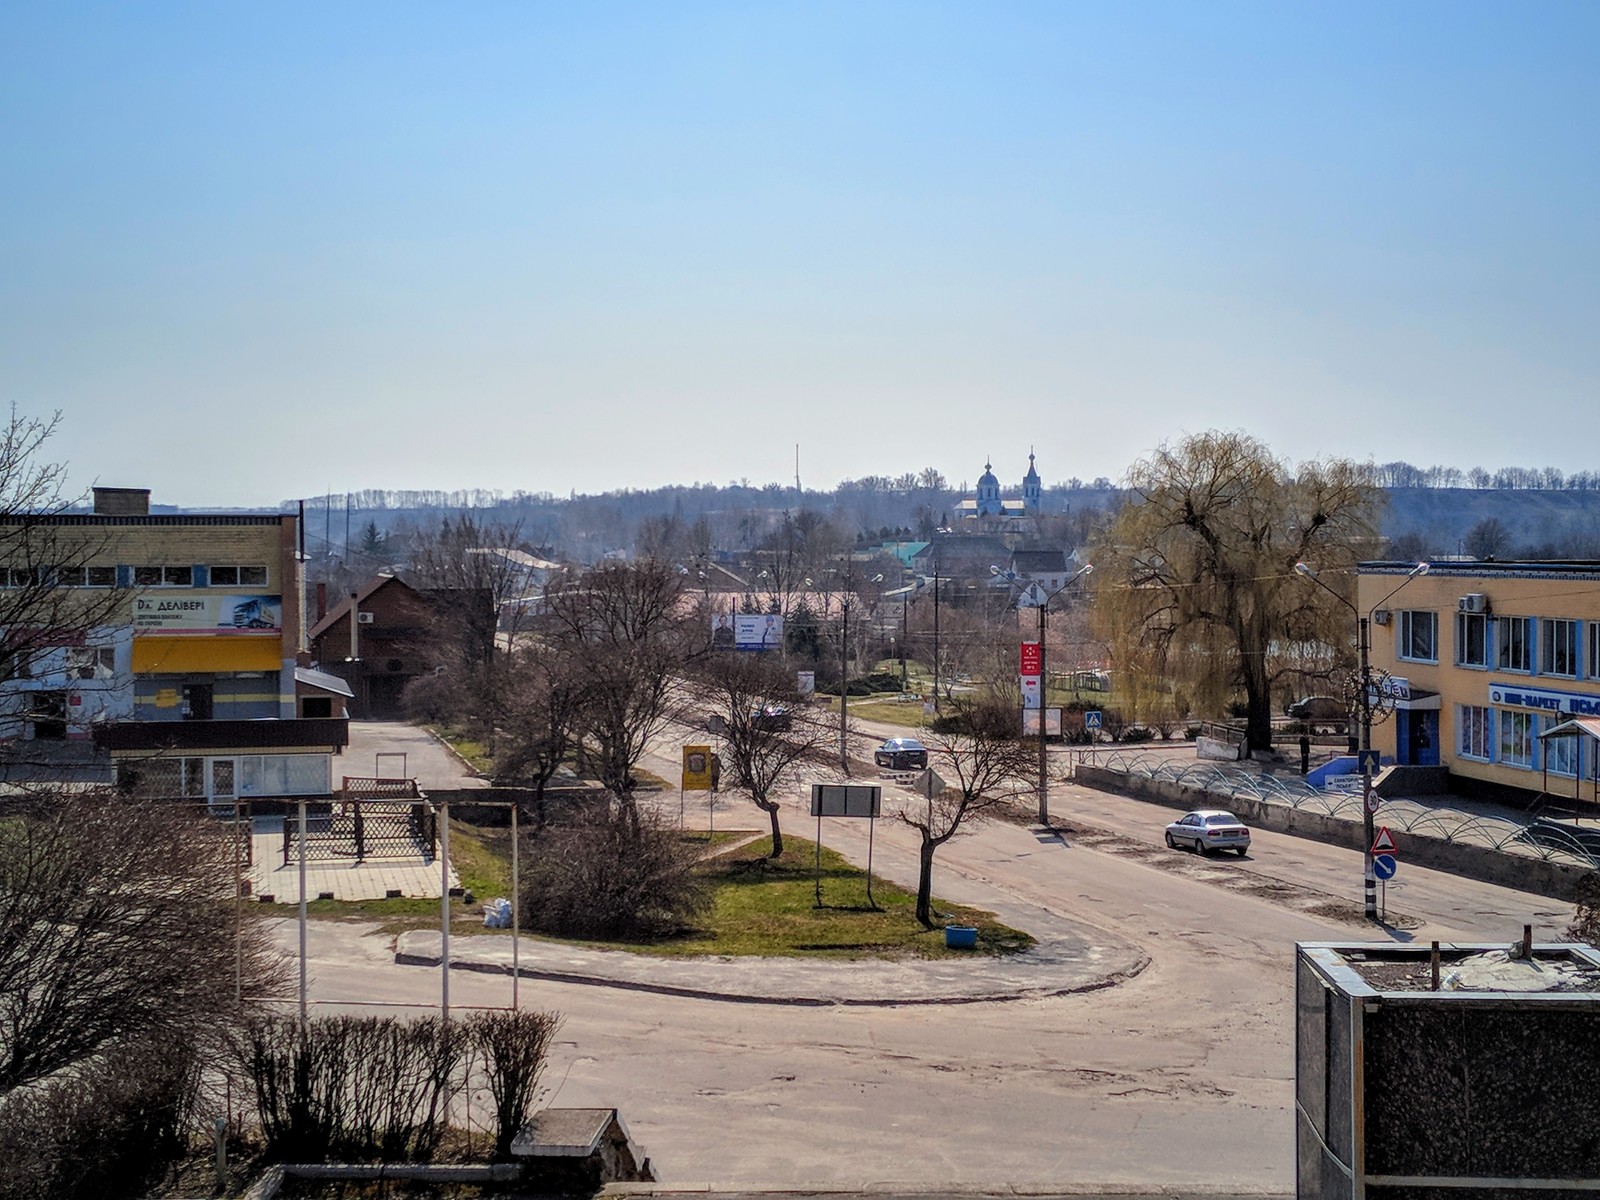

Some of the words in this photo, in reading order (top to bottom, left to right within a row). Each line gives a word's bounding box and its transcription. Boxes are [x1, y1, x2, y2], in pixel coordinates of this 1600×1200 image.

[158, 602, 205, 611] ДЕЛІВЕРІ
[1504, 692, 1561, 711] -МАРКЕТ
[1370, 795, 1377, 806] 30
